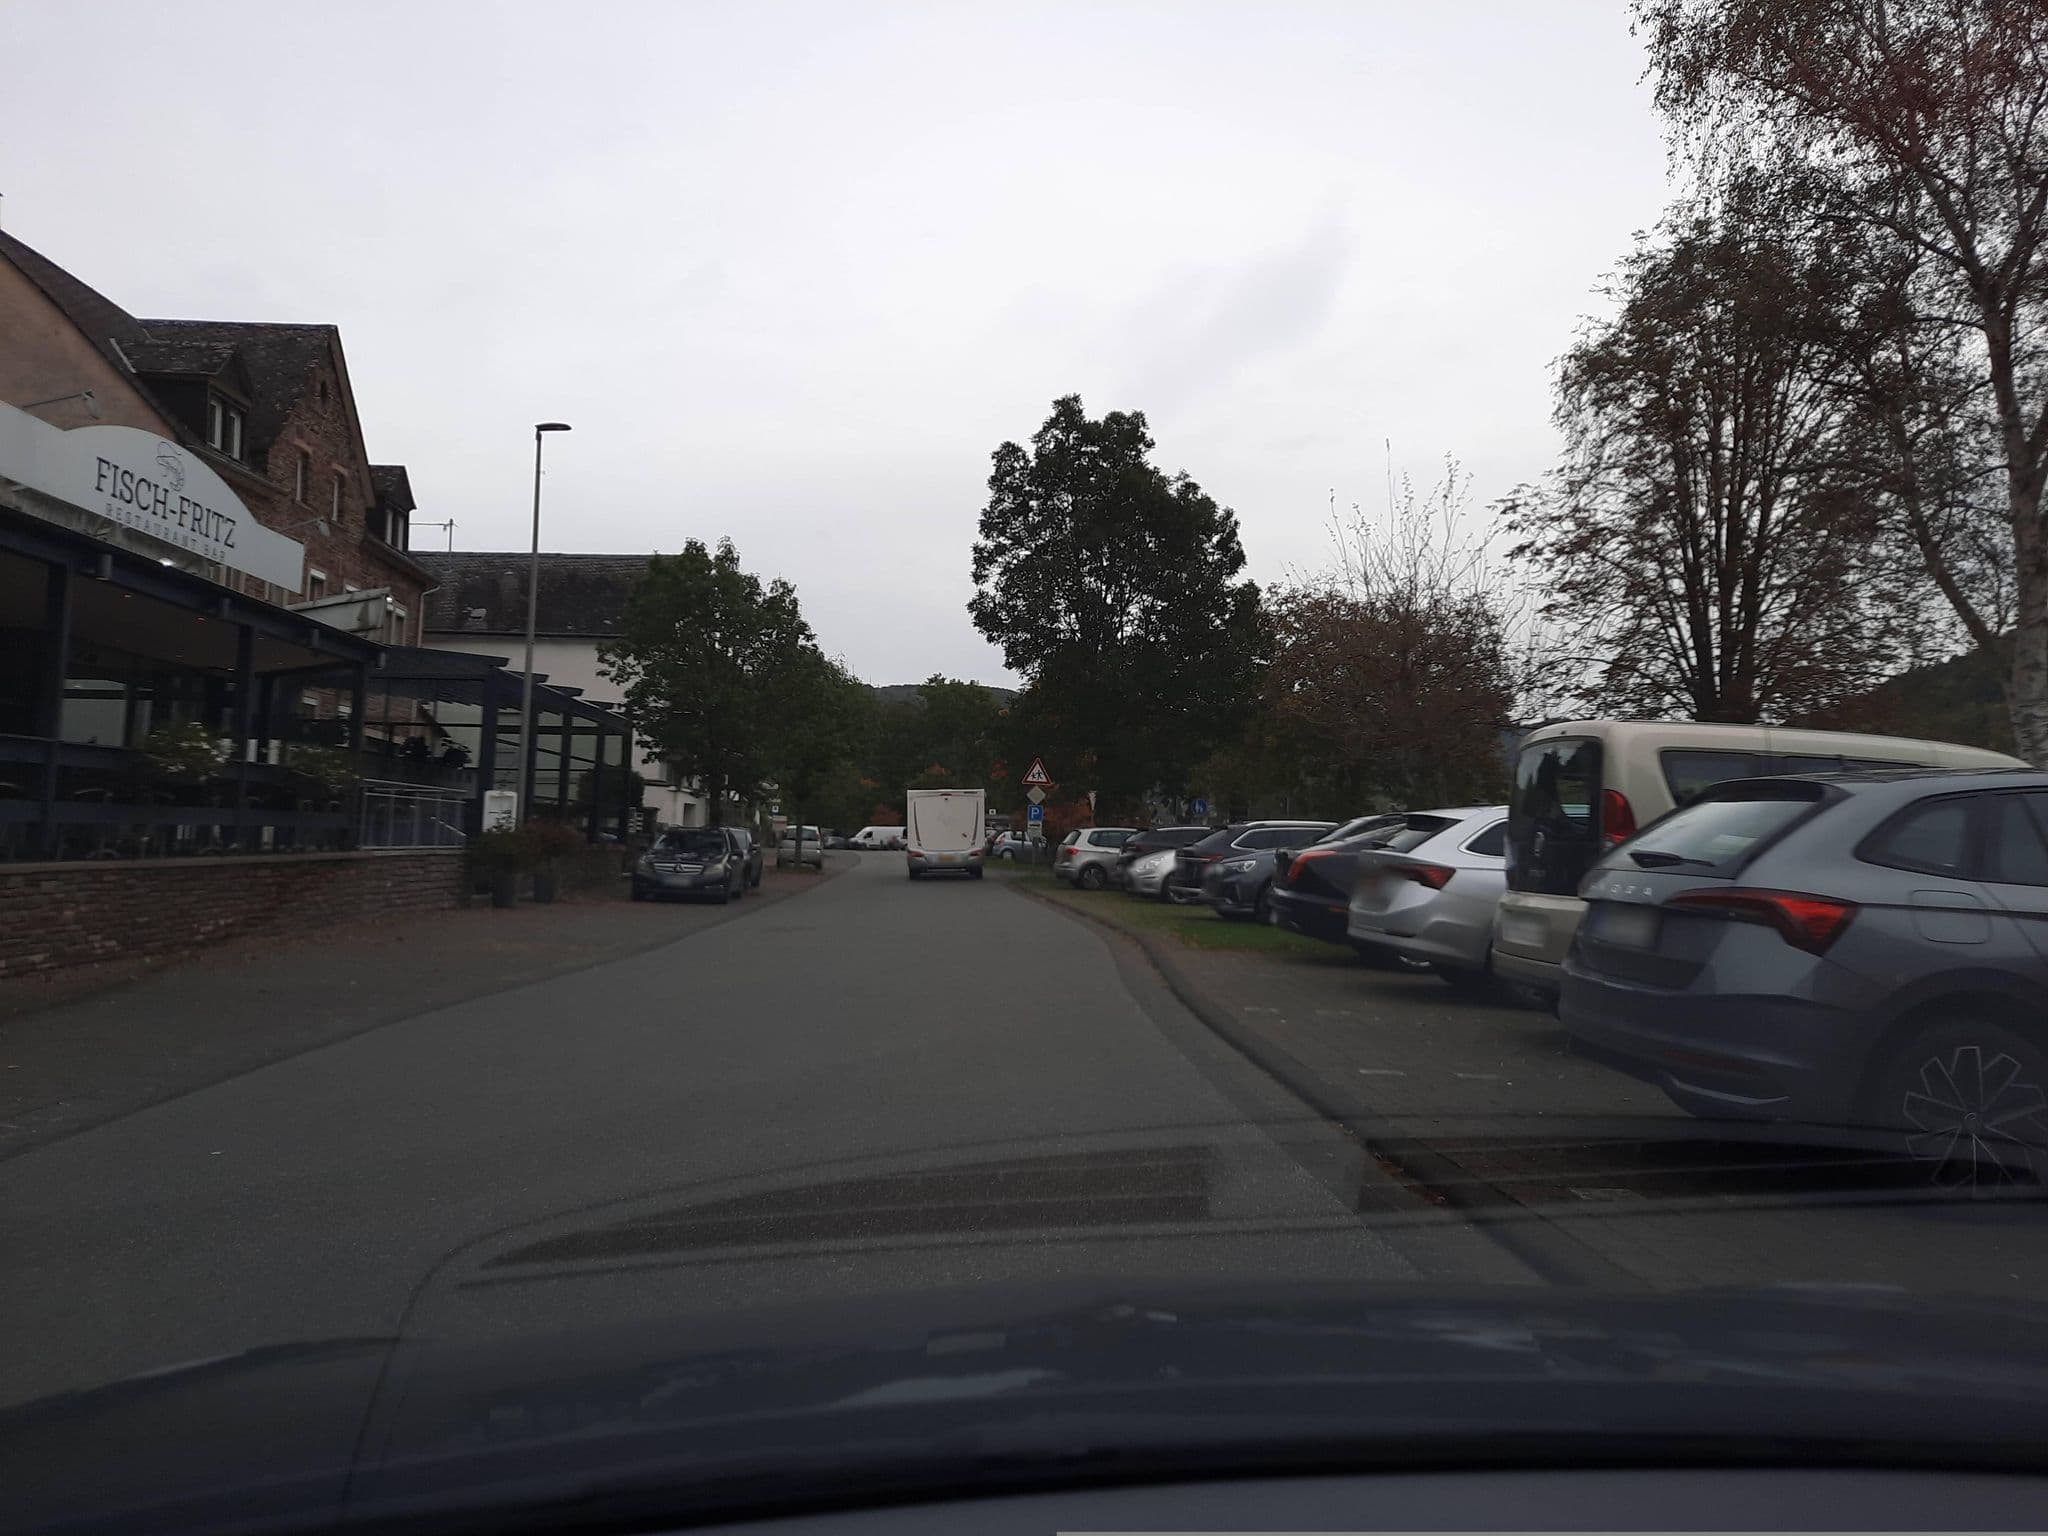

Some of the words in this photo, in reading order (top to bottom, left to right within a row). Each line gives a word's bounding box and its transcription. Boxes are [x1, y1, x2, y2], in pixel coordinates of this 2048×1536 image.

[95, 457, 237, 548] FISCH-FRITZ
[106, 503, 198, 547] RESTAURANT
[1031, 807, 1040, 819] P
